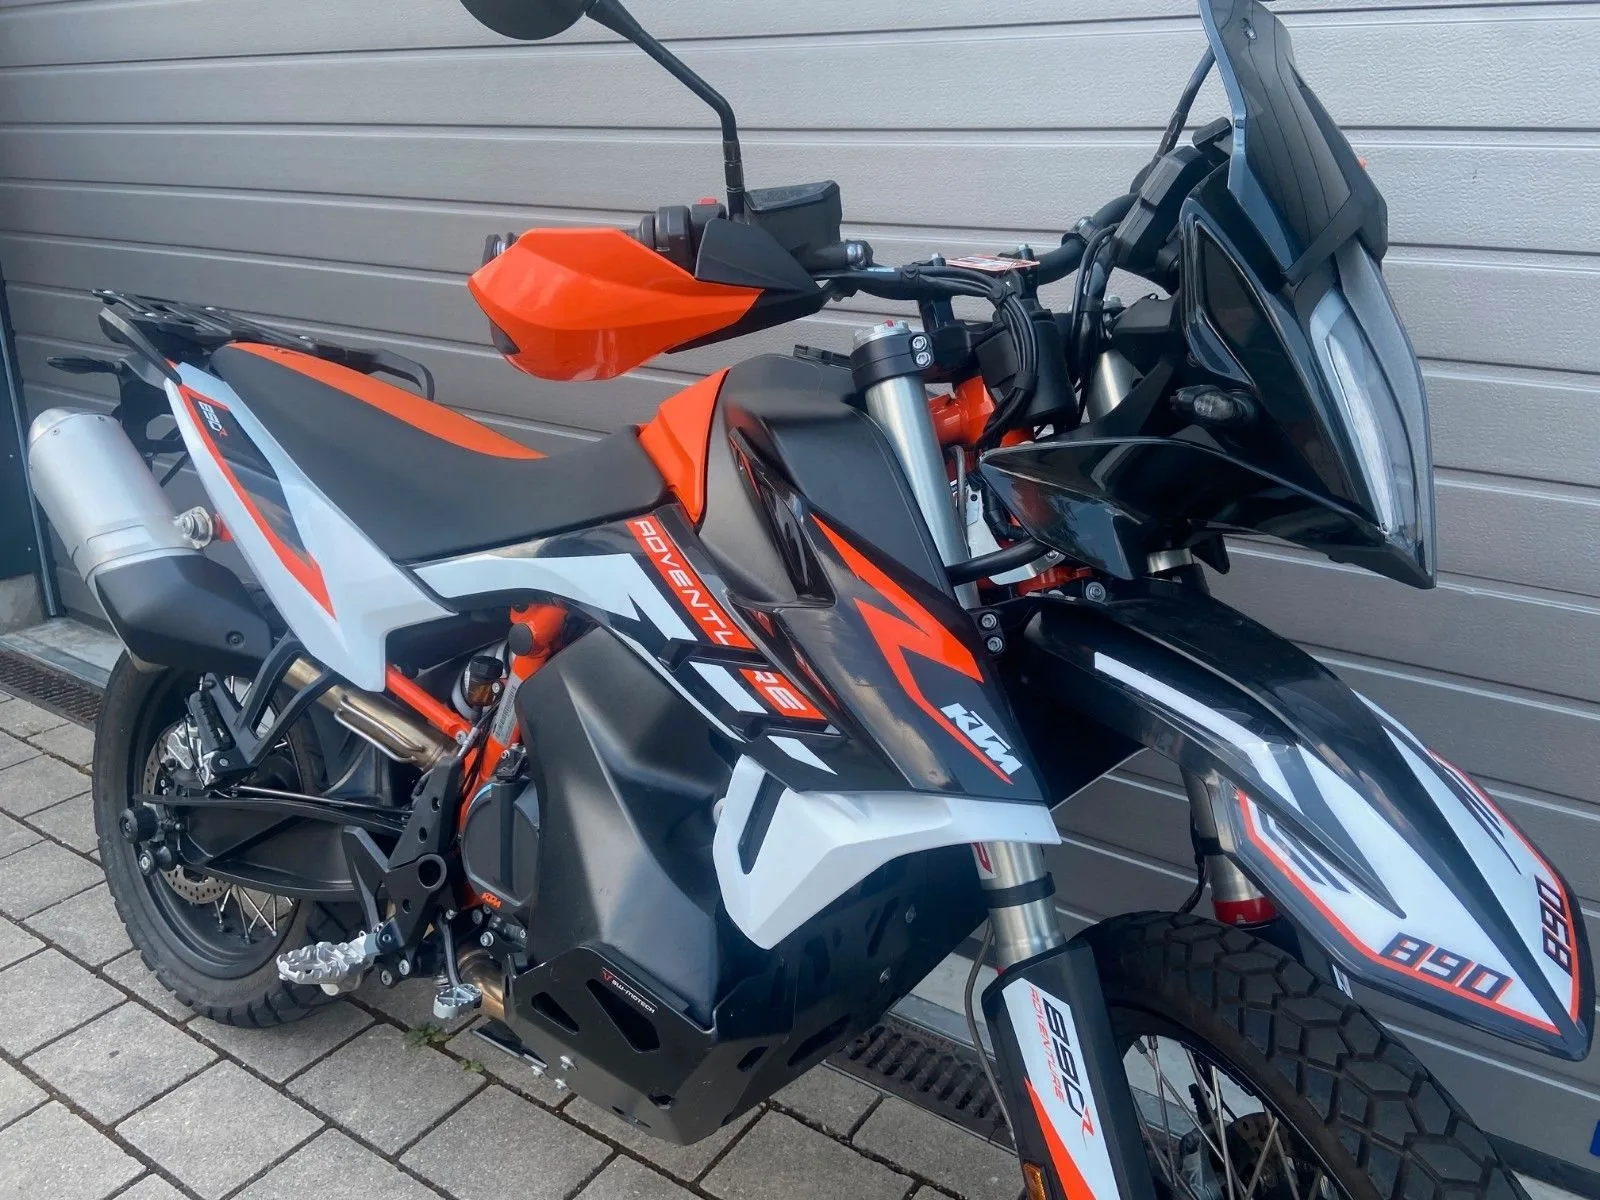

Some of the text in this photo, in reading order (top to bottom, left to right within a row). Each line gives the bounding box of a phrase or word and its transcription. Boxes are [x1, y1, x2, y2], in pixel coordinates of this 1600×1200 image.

[940, 703, 1022, 775] KTM
[481, 891, 502, 909] KTM
[1535, 875, 1572, 977] 890
[1379, 932, 1513, 1001] 890
[1030, 986, 1065, 1103] ADVENTURE
